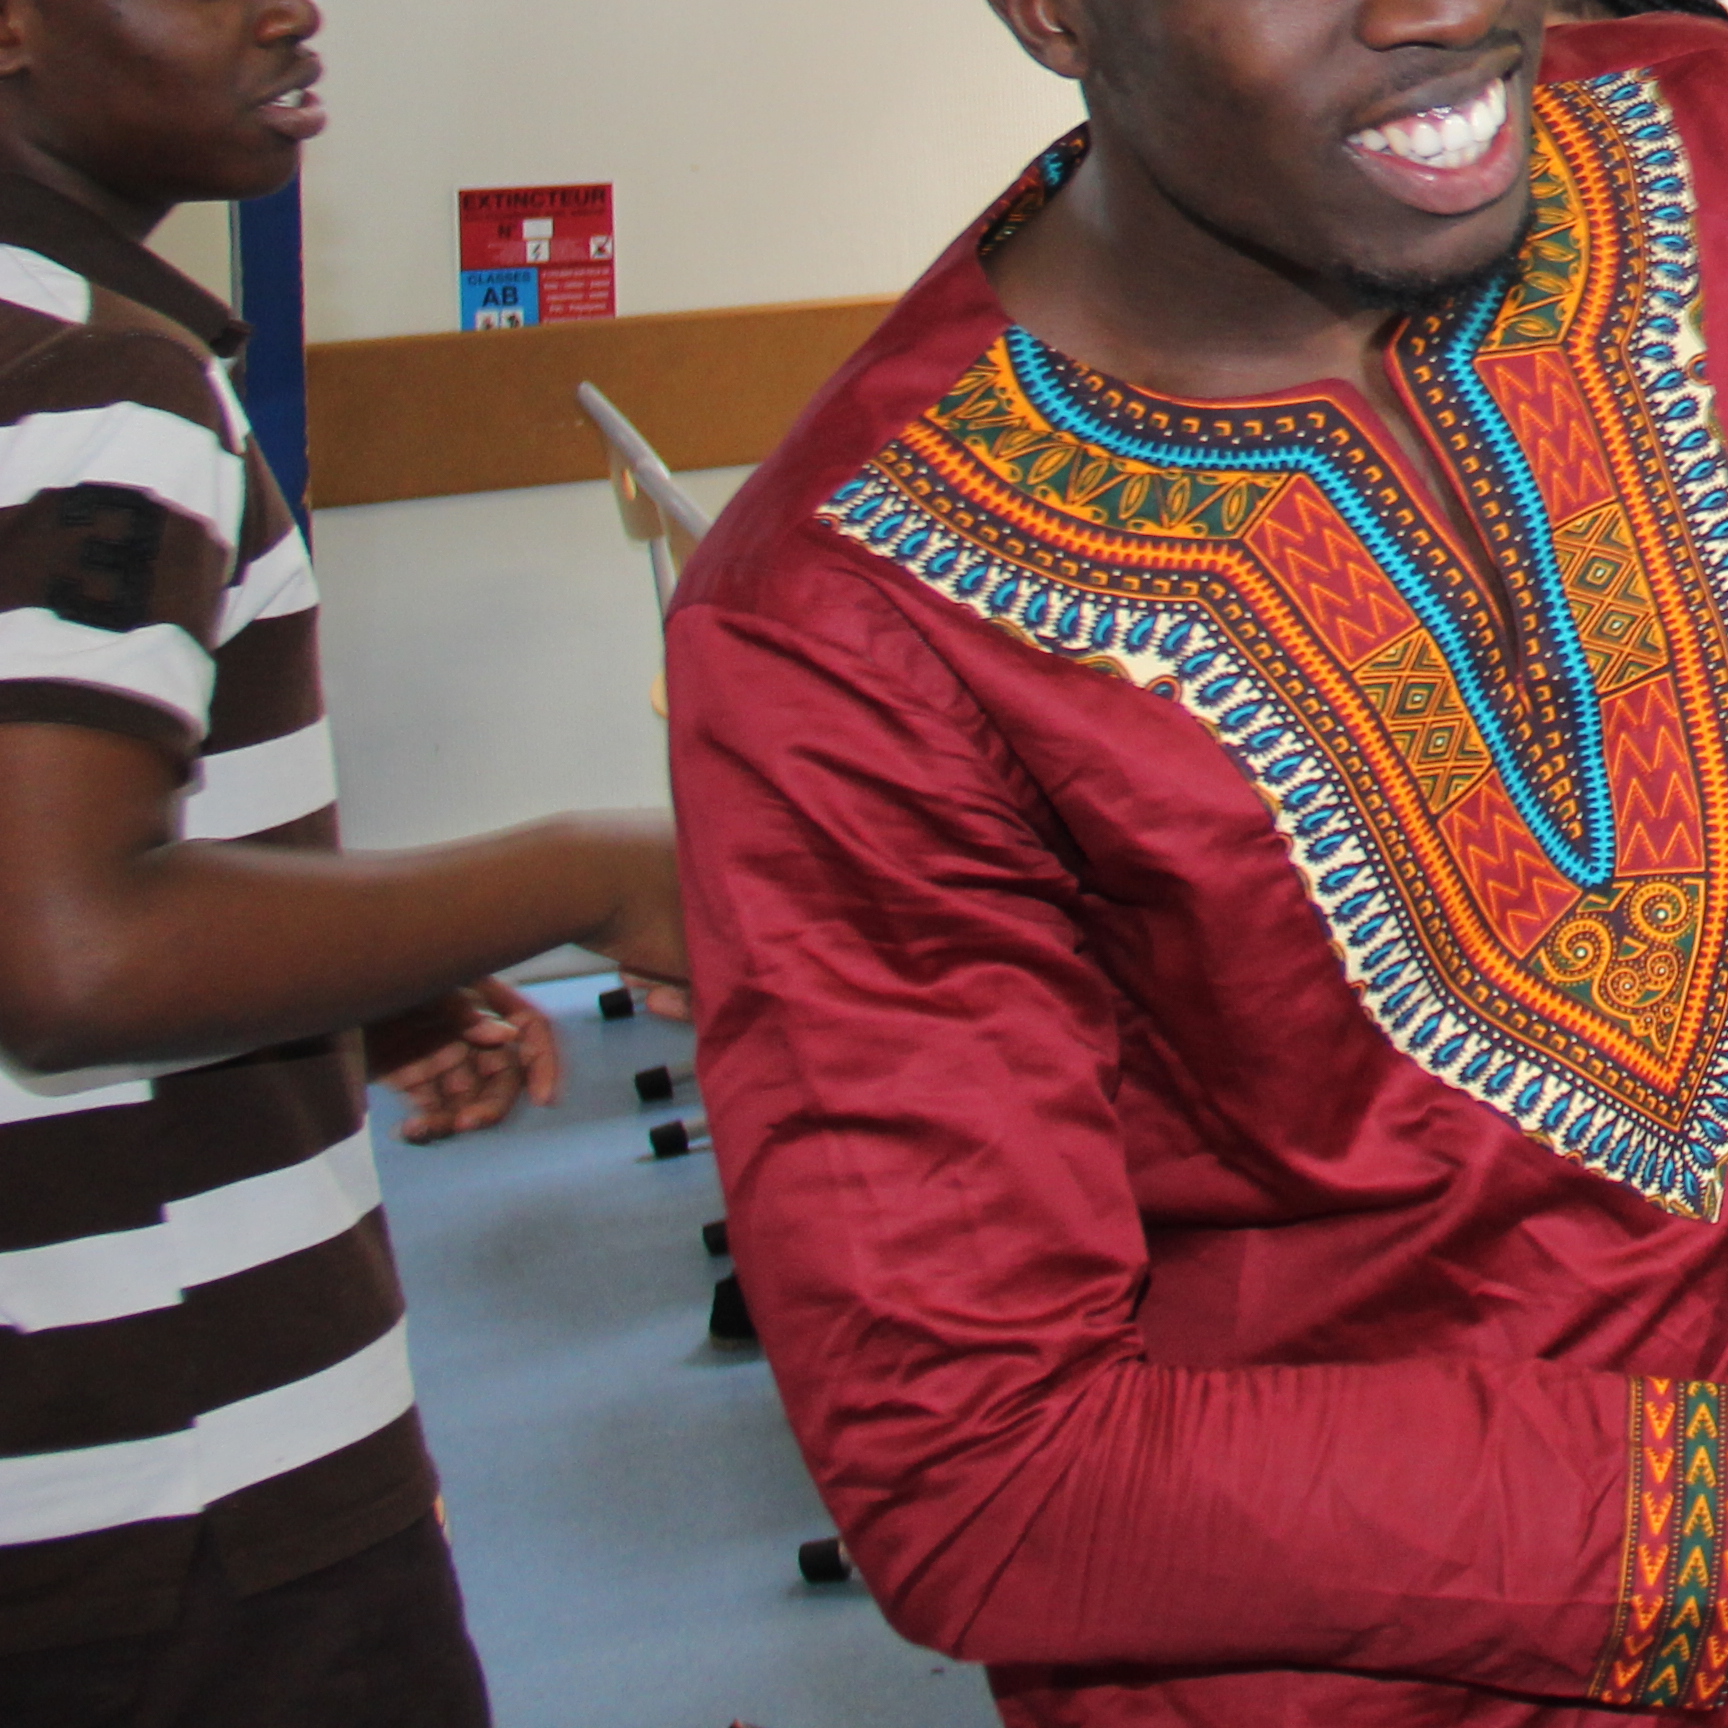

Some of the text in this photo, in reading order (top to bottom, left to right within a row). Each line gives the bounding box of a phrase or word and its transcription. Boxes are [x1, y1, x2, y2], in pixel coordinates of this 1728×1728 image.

[463, 187, 606, 211] EXTINCTEUR
[467, 272, 532, 286] CLASSES
[482, 285, 520, 307] AB
